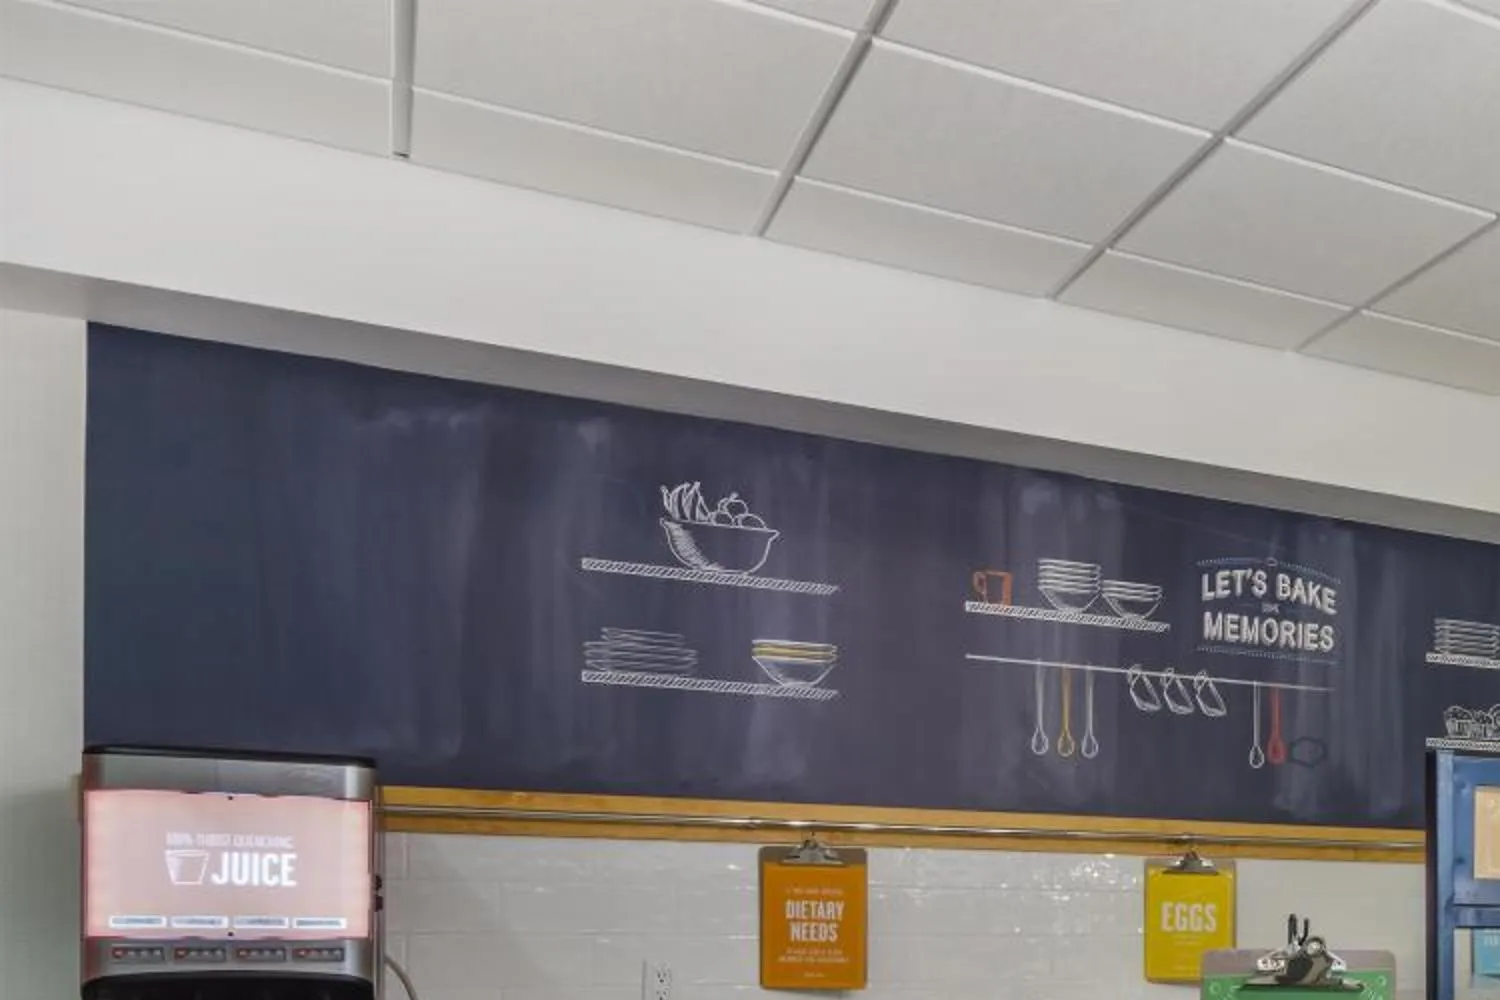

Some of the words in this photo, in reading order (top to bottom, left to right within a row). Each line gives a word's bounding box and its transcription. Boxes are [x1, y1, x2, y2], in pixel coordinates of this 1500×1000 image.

[1202, 569, 1268, 601] LET'S
[1276, 573, 1337, 615] BAKE
[1203, 611, 1335, 652] MEMORIES
[211, 851, 298, 887] JUICE
[785, 899, 845, 921] DIETARY
[1161, 901, 1217, 932] EGGS
[791, 922, 839, 942] NEEDS
